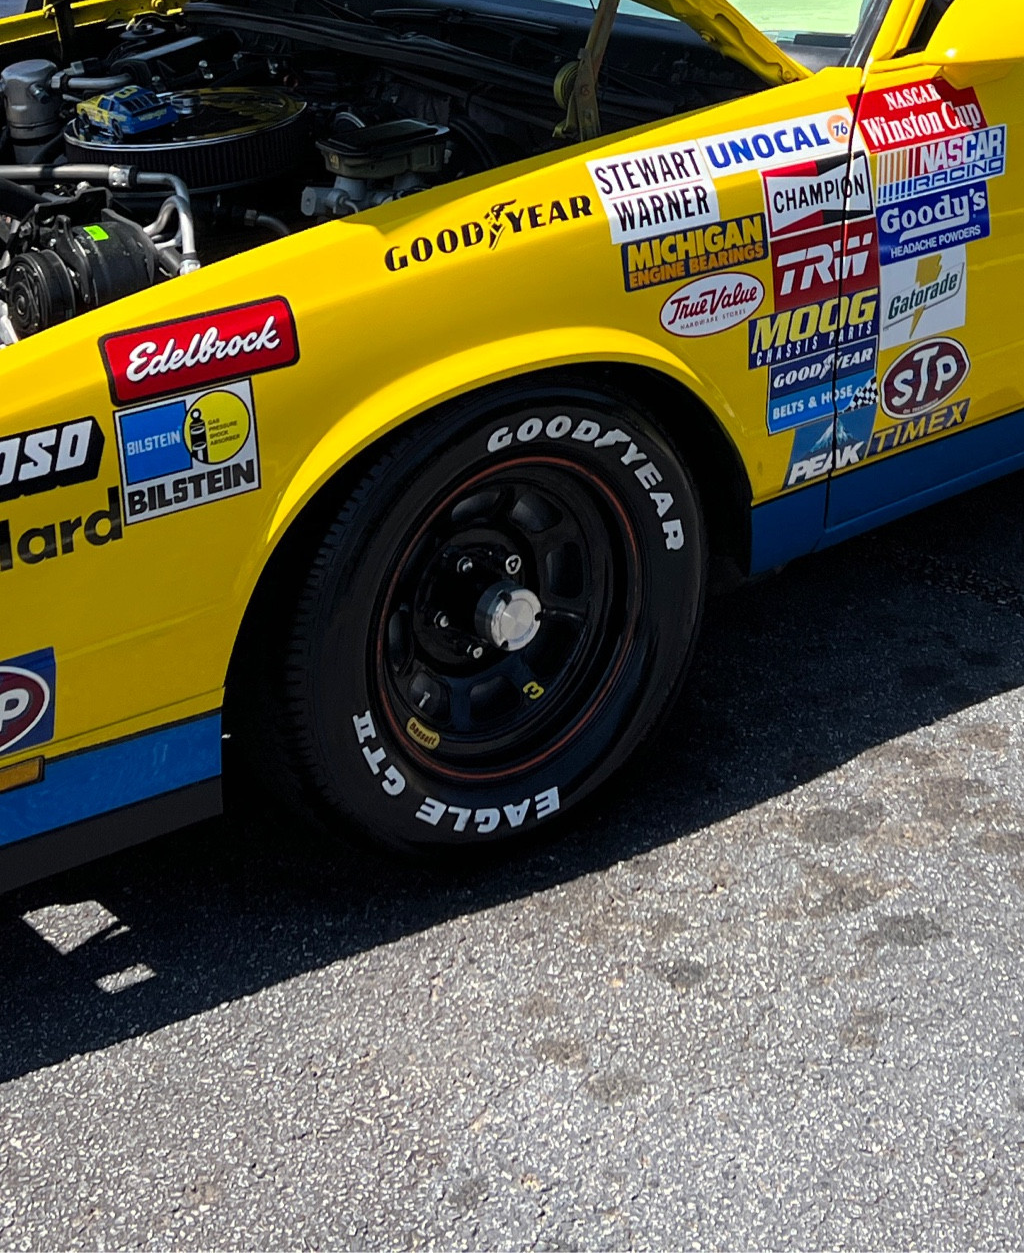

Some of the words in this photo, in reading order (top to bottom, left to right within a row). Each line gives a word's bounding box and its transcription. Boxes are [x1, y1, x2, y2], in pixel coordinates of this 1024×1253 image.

[883, 84, 941, 110] NASCAR
[706, 124, 829, 169] UNOCAL
[833, 122, 848, 137] 76
[862, 111, 944, 146] Winston
[941, 101, 981, 130] Cup
[594, 148, 701, 195] STEWART
[914, 157, 1004, 191] RACING
[919, 129, 1002, 175] NASCAR
[612, 185, 710, 232] WARNER
[773, 173, 865, 213] CHAMPION
[881, 188, 986, 244] Goody's
[384, 195, 593, 272] GOODYEAR
[627, 215, 763, 273] MICHIGAN
[890, 237, 938, 259] HEADACHE
[938, 225, 981, 244] POWDERS
[629, 260, 685, 288] ENGINE
[689, 243, 764, 274] BEARINGS
[777, 232, 873, 296] TRW
[668, 296, 708, 326] True
[699, 282, 758, 316] Value
[888, 270, 958, 320] Gatorade
[680, 315, 718, 330] HARDWARE
[722, 308, 747, 320] STORES
[751, 287, 879, 355] MOOG
[126, 315, 280, 382] Edelbrock
[756, 336, 819, 366] CHASSIS
[828, 321, 873, 346] PARTS
[891, 346, 958, 407] STP
[772, 400, 805, 421] BELTS
[807, 394, 818, 409] &
[821, 384, 854, 406] HOSE
[126, 429, 181, 457] BILSTEIN
[876, 400, 967, 453] TIMEX
[487, 415, 685, 551] GOODYEAR
[787, 440, 865, 487] PEAK
[127, 458, 256, 517] BILSTEIN
[415, 786, 562, 834] EAGLE
